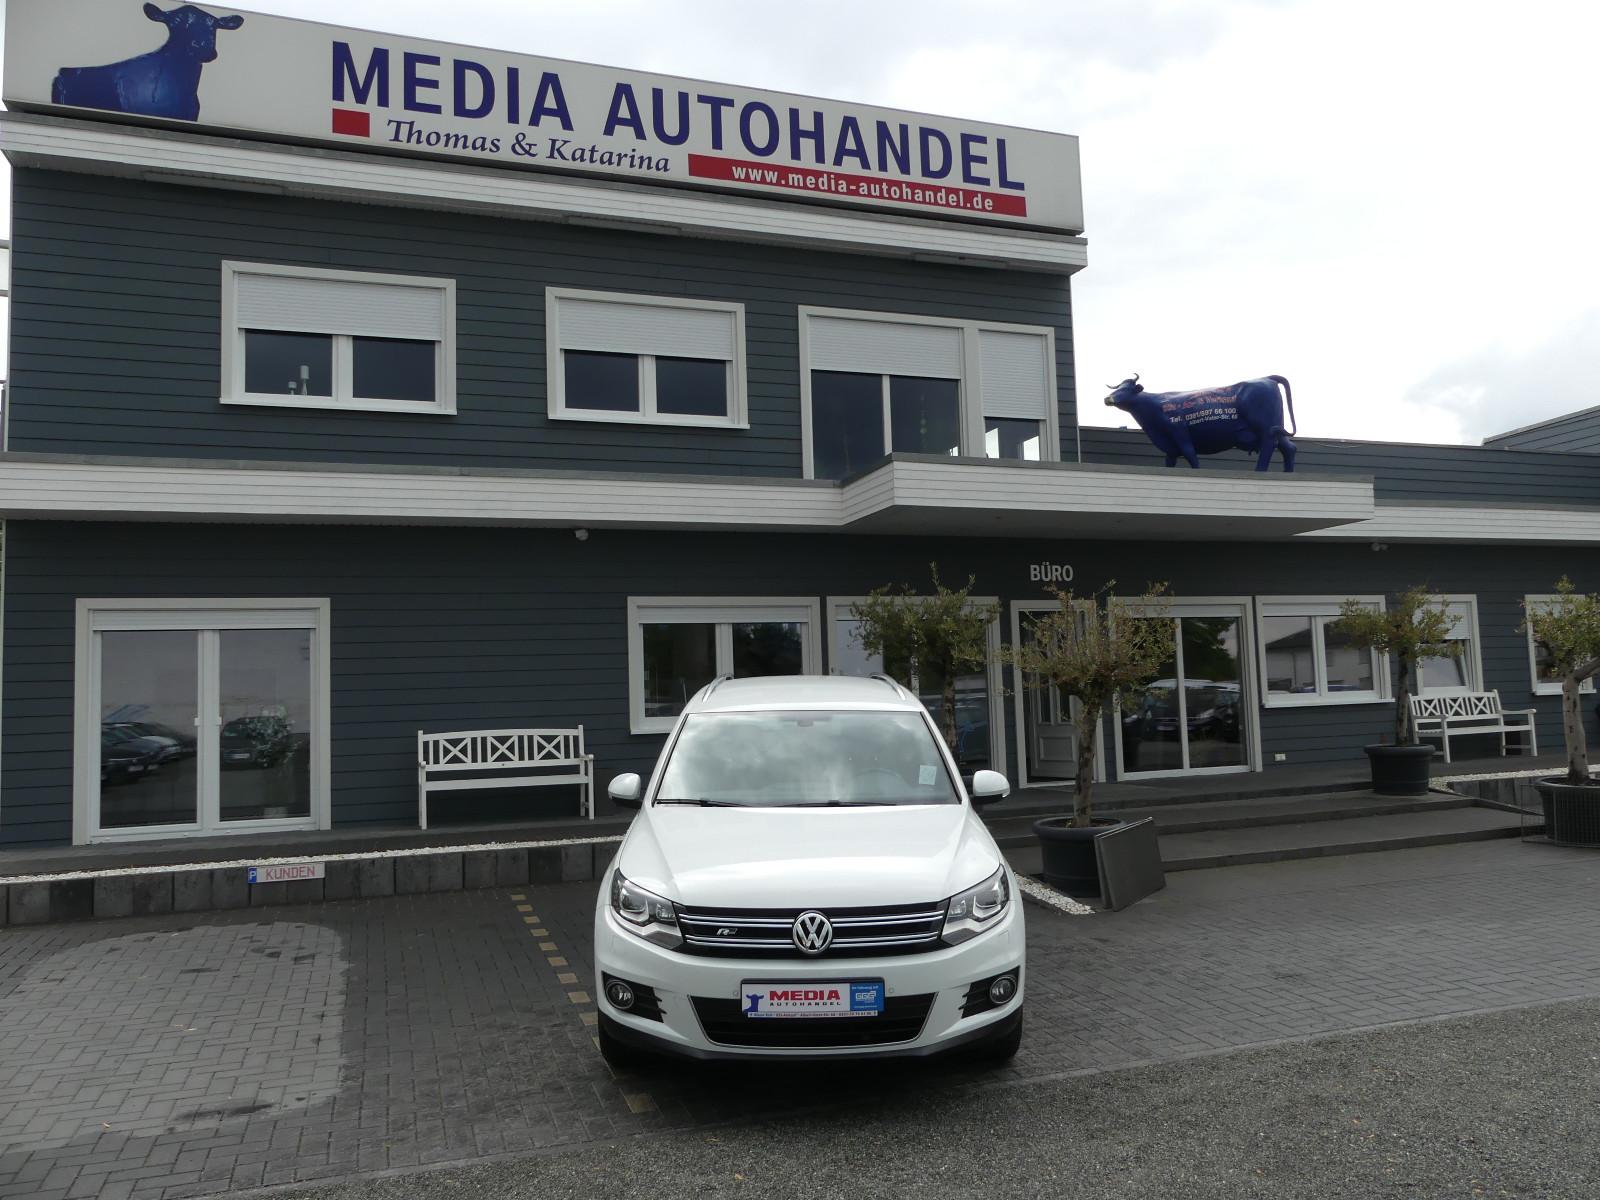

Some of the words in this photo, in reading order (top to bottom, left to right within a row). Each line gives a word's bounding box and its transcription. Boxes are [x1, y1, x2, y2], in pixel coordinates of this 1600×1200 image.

[332, 40, 575, 132] MEDIA
[602, 82, 1026, 192] AUTOHANDEL
[387, 119, 501, 154] Thomas
[510, 131, 538, 158] &
[546, 138, 671, 173] Katarina
[731, 164, 994, 212] www.media-autohandel.de
[1030, 561, 1074, 582] BÜRO
[249, 870, 257, 880] P
[265, 865, 316, 881] KUNDEN
[769, 989, 841, 1002] MEDIA
